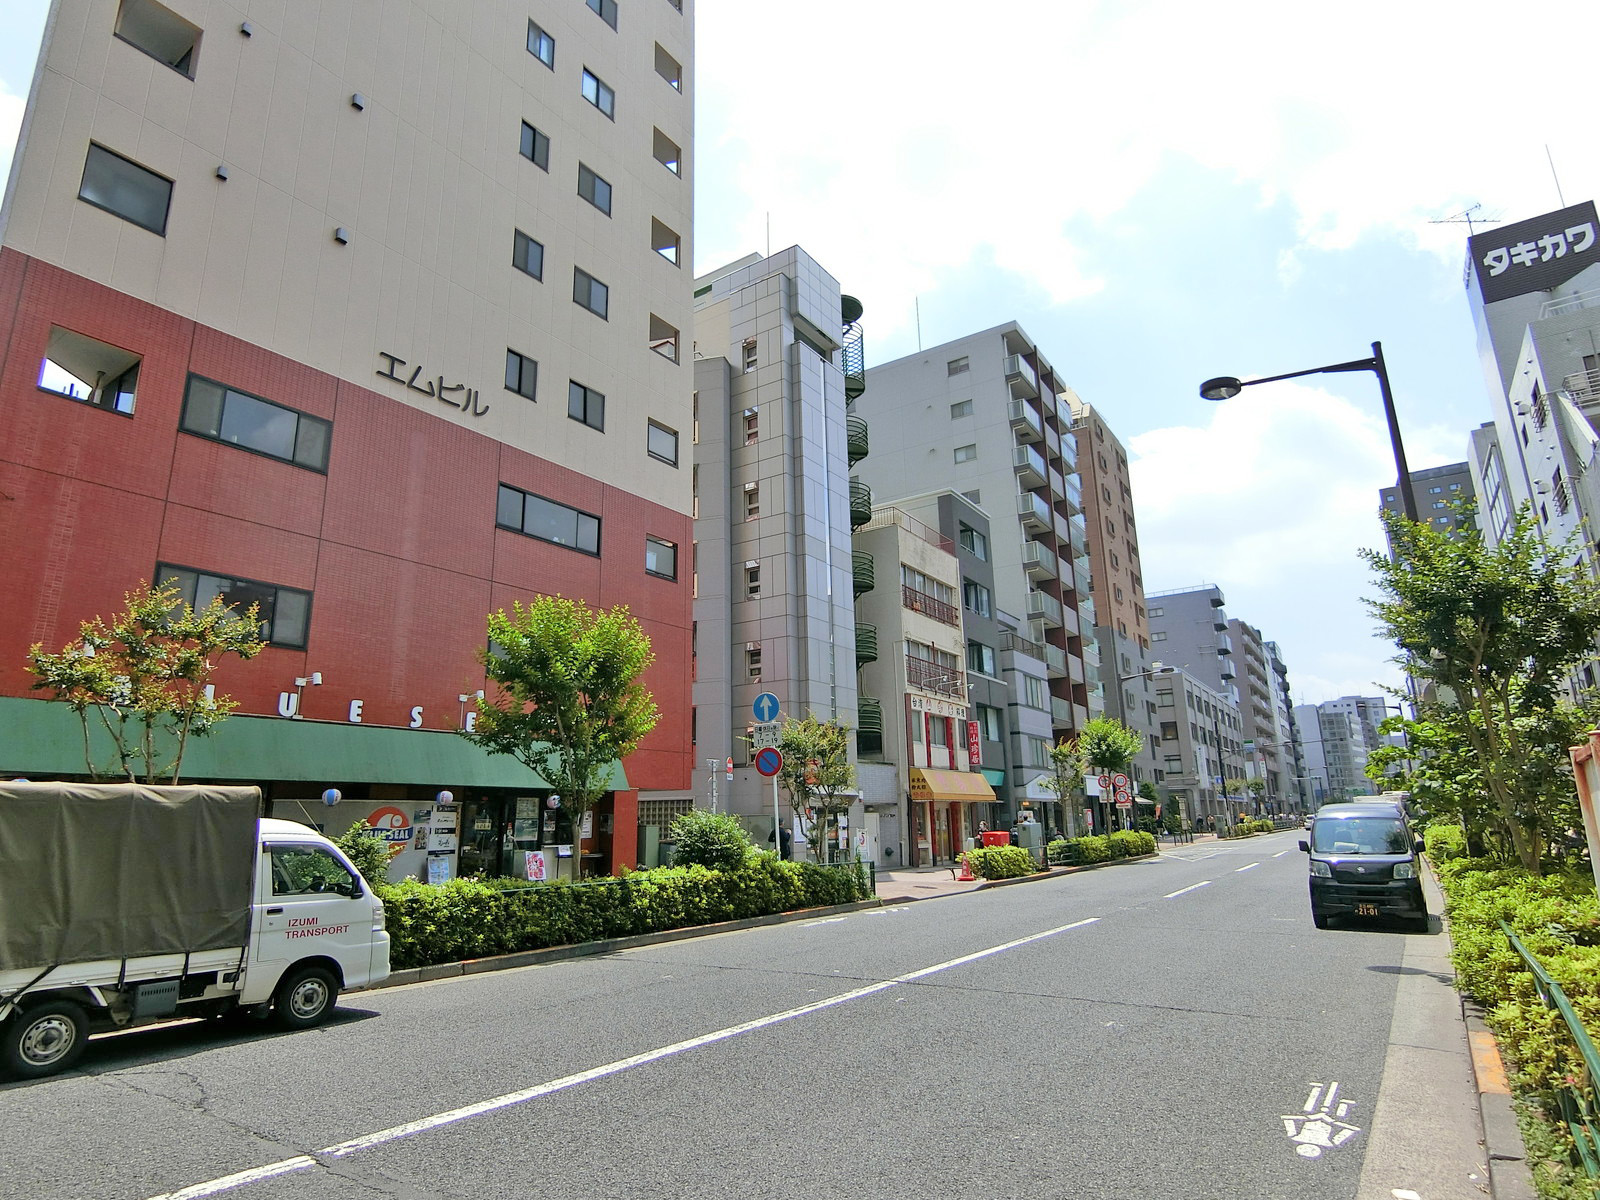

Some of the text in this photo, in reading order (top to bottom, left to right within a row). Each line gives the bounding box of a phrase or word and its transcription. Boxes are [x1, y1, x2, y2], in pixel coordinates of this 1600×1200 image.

[1483, 222, 1596, 277] タキカワ
[376, 352, 490, 416] エムビル
[388, 829, 409, 840] SEAL
[288, 917, 318, 927] IZUMI
[285, 925, 349, 939] TRANSPORT
